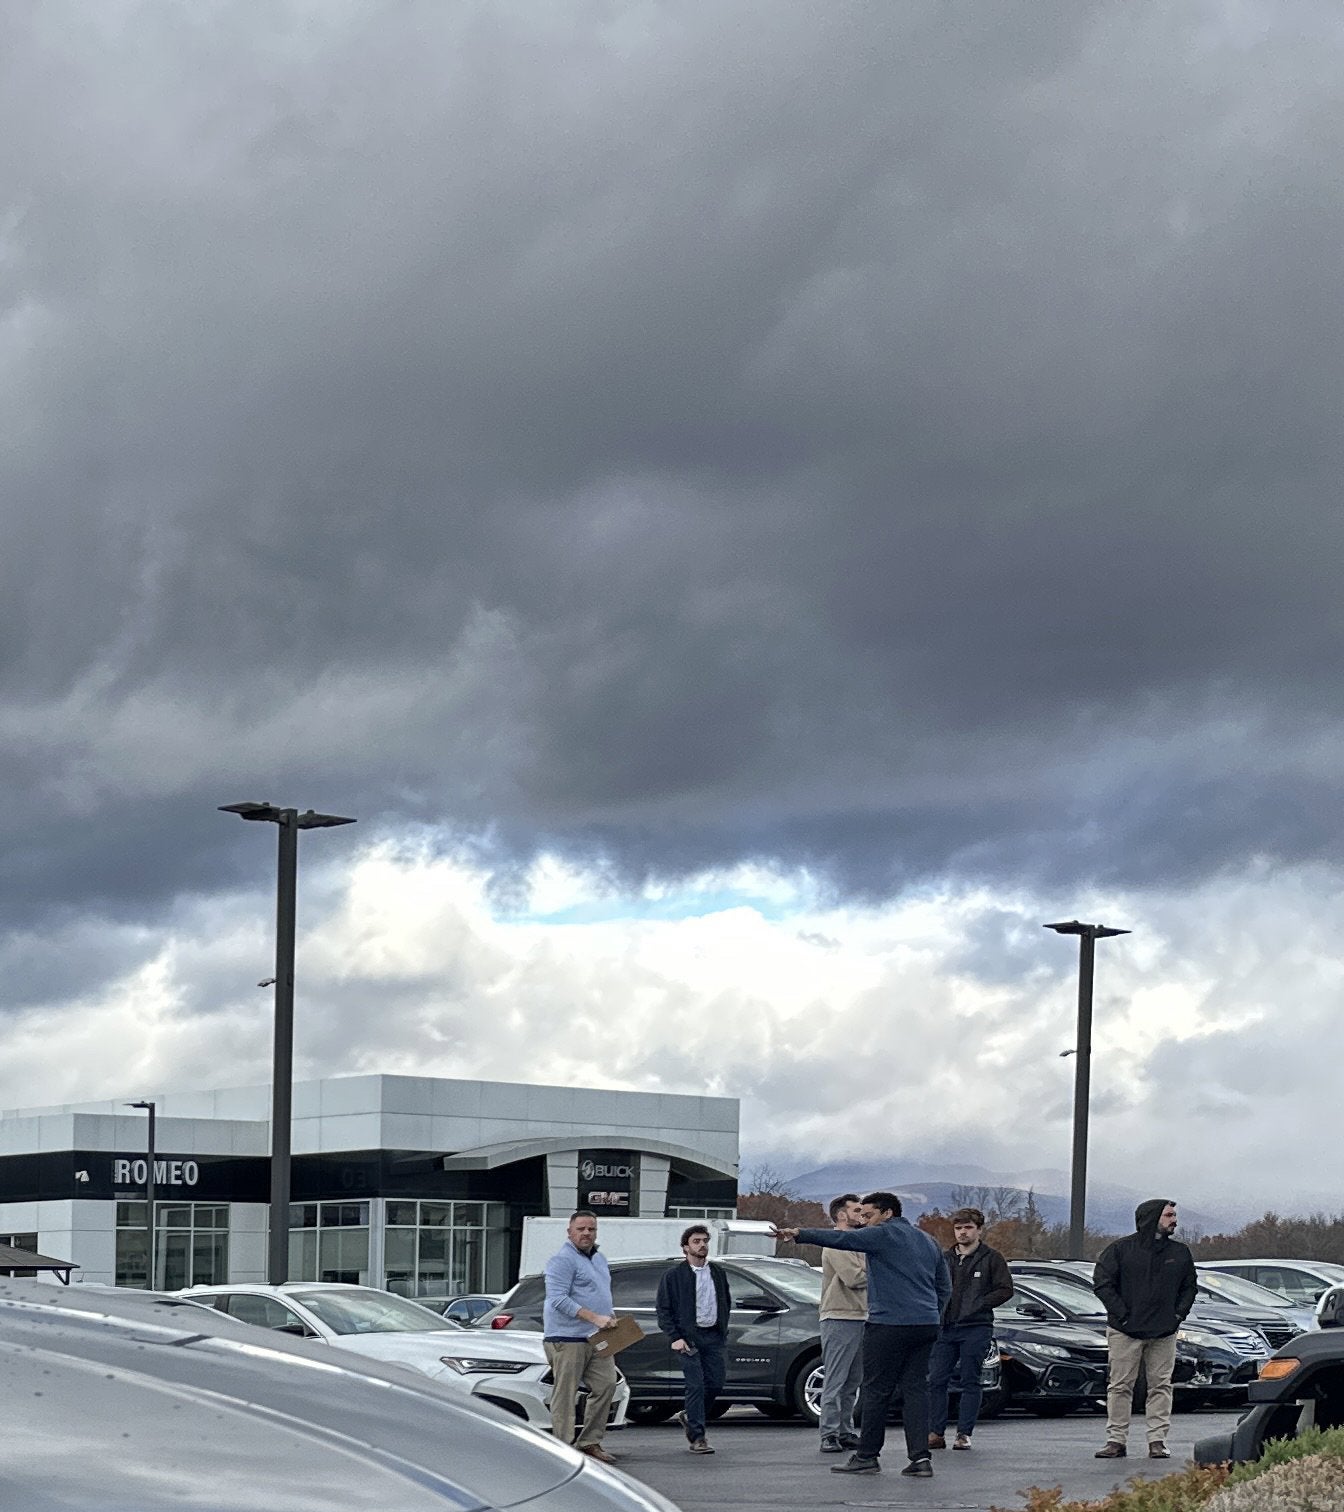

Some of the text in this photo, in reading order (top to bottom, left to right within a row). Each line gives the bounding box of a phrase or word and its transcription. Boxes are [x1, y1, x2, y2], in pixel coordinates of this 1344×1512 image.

[114, 1159, 199, 1185] ROMEO
[595, 1165, 635, 1178] BUICK
[588, 1191, 629, 1206] GMC
